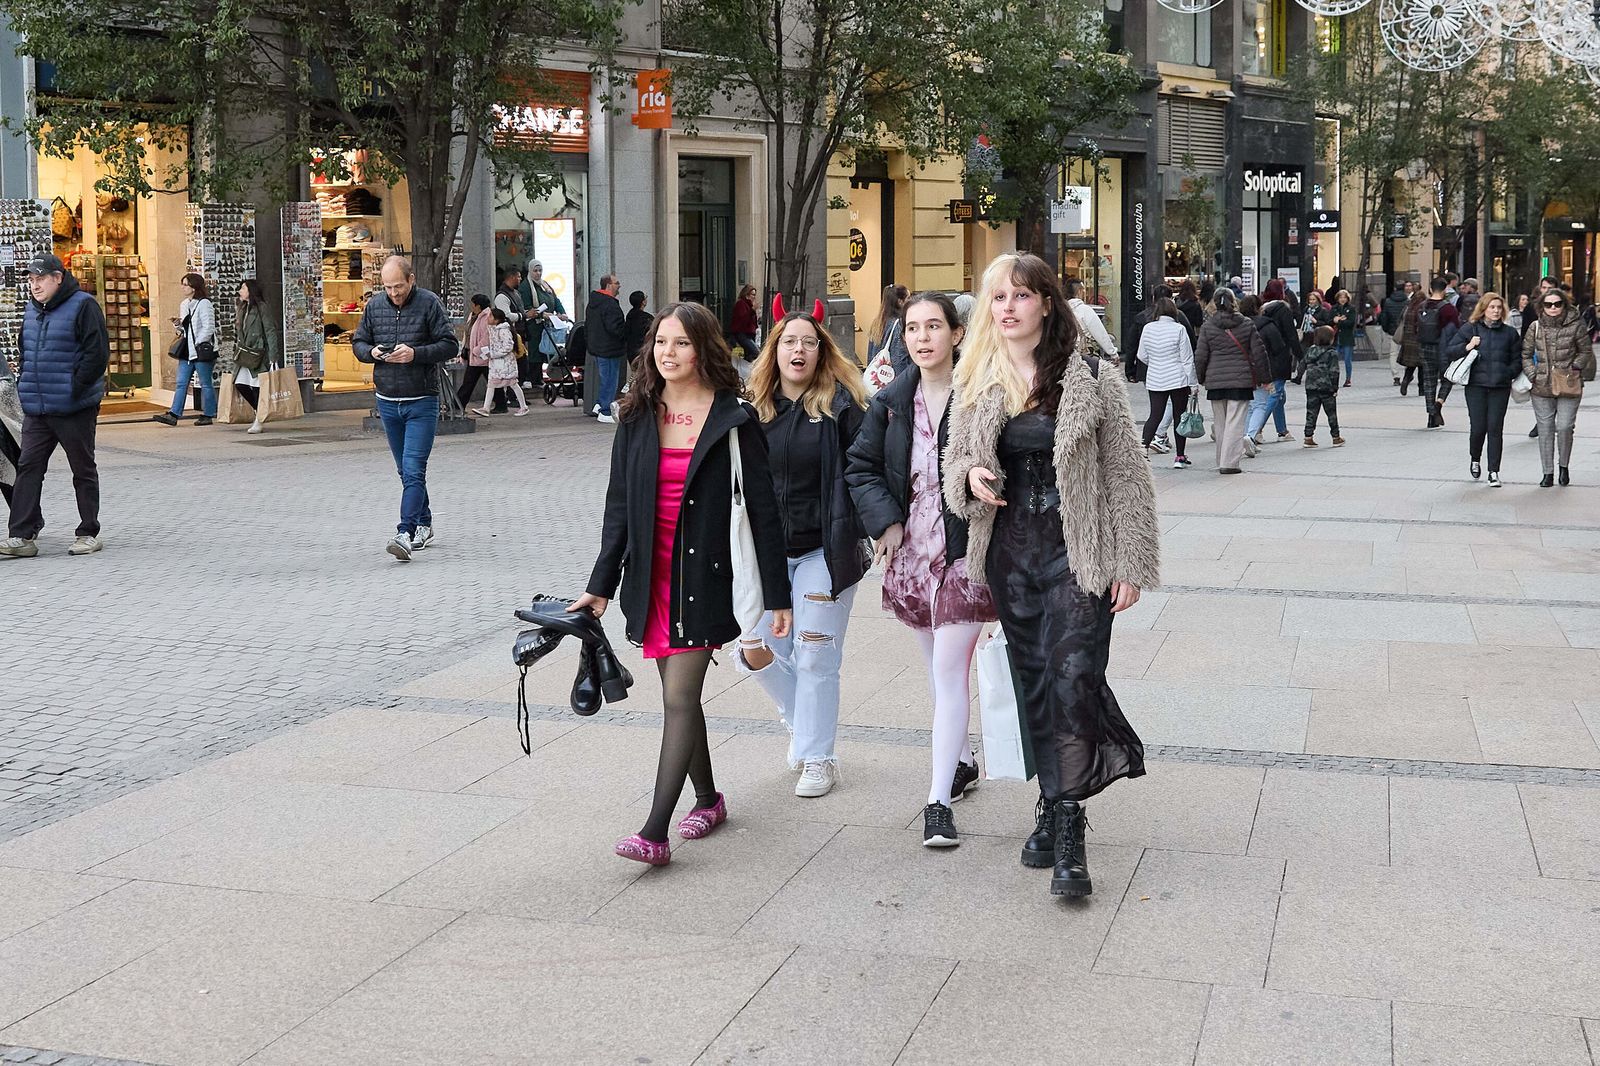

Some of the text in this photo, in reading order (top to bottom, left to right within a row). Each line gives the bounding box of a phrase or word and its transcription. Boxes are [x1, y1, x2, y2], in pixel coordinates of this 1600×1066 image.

[641, 85, 666, 108] ria
[1244, 169, 1302, 198] Soloptical
[1053, 211, 1066, 220] gift
[1133, 202, 1143, 300] selected souvenirs
[664, 413, 693, 426] KISS
